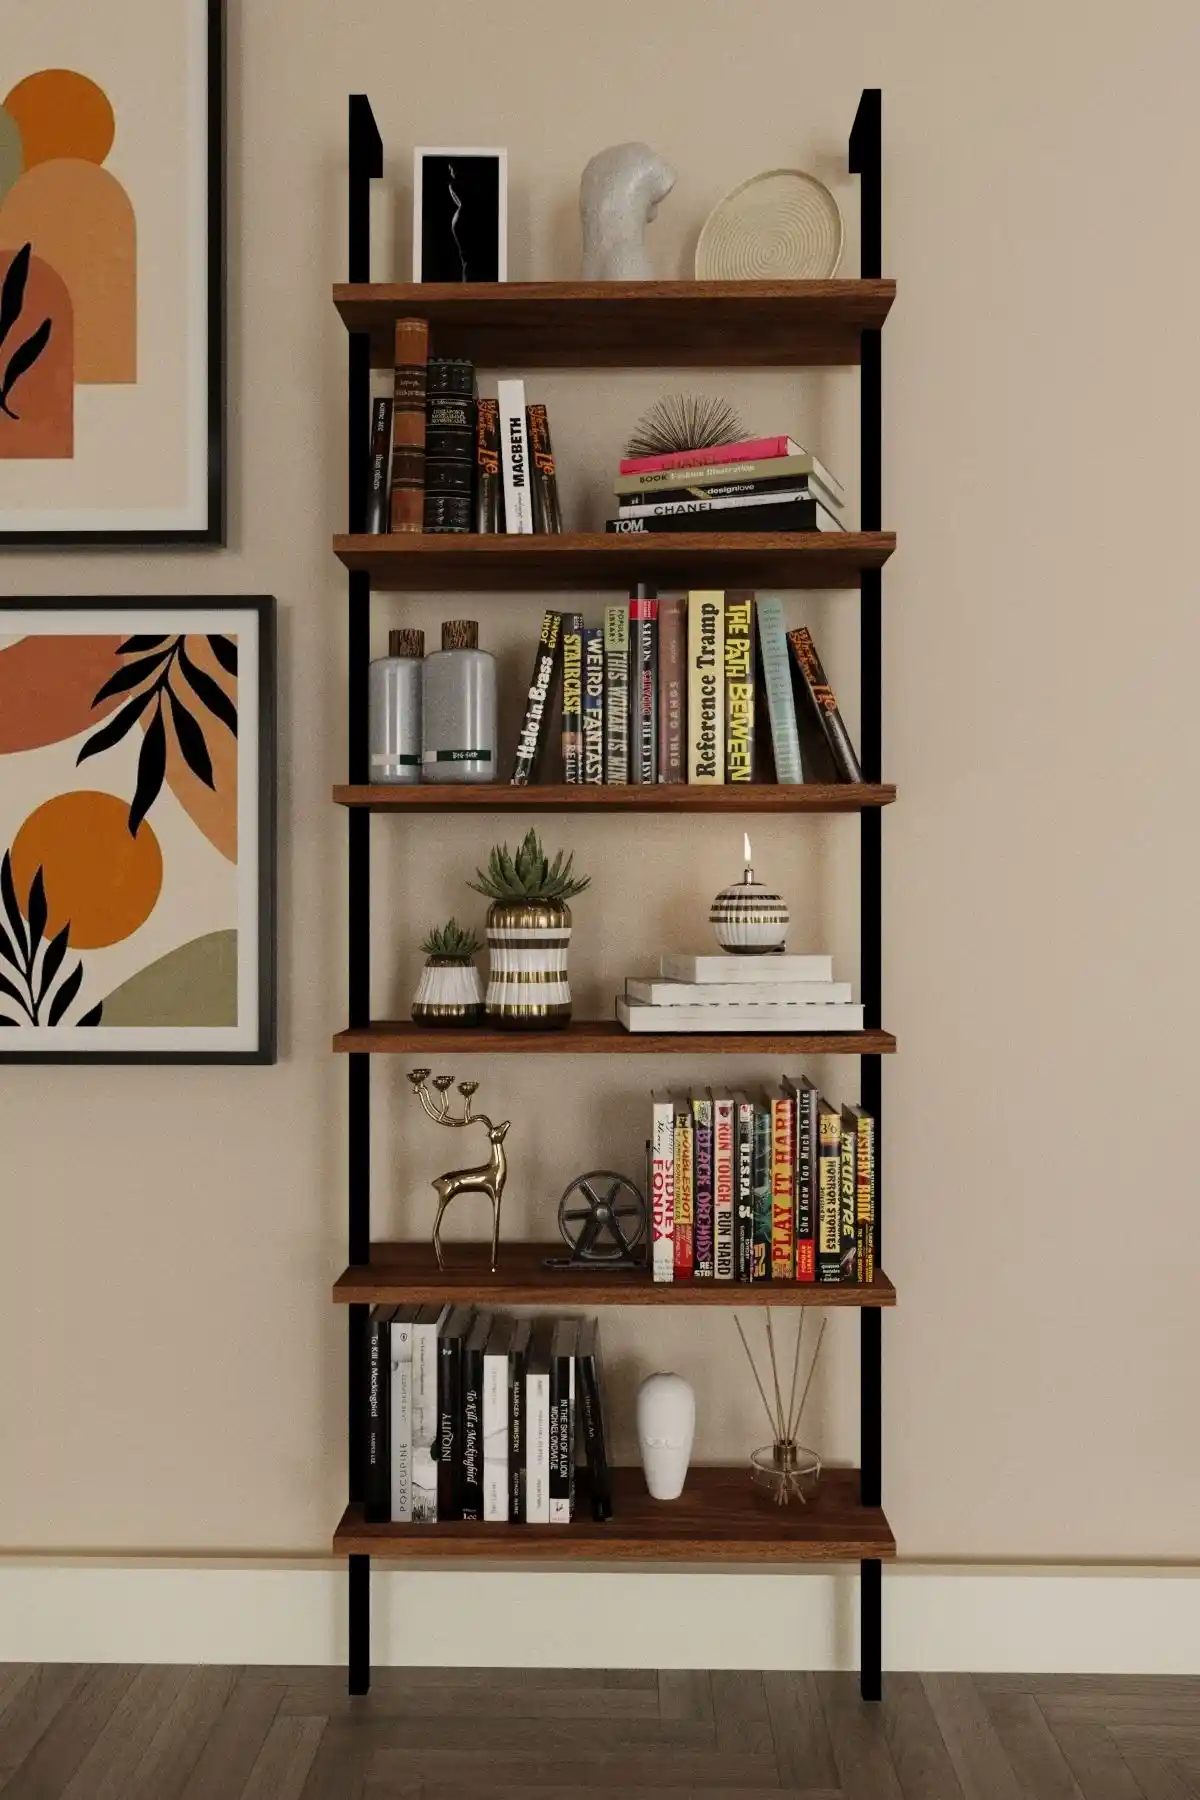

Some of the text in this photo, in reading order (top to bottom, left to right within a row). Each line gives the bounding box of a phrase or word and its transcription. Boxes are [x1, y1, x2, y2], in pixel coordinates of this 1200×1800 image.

[510, 417, 524, 488] MACBETH
[640, 473, 668, 484] BOOK
[707, 484, 755, 496] designlove
[614, 519, 644, 533] TOM
[540, 614, 551, 644] JOHN
[548, 616, 561, 648] EVANS
[608, 609, 616, 643] LIBRARY
[617, 609, 625, 644] POPULAR
[563, 635, 582, 715] STAIRCASE
[607, 652, 627, 680] THIS
[696, 602, 717, 778] Reference Tramp
[725, 600, 754, 781] THE PATH BETWEEN
[517, 656, 554, 759] Halo in Brass
[583, 638, 602, 784] WEIRD FANTASY
[607, 686, 627, 733] WOMAN
[670, 680, 680, 767] GIRL GANGS
[565, 744, 576, 784] REILLY
[607, 738, 627, 752] IS
[681, 1130, 691, 1220] DOUBLESHOT
[740, 1143, 750, 1200] U.E.S.P.A.
[773, 1100, 792, 1261] PLAY IT HARD
[799, 1092, 810, 1233] She Knew Too Much To Live
[841, 1134, 855, 1239] MEURTRE
[858, 1118, 872, 1221] MYSTERY BOOK
[653, 1160, 664, 1242] FONDA
[665, 1160, 674, 1240] SIDNEY
[697, 1129, 712, 1262] BLACK ORCHIDS
[716, 1123, 732, 1276] RUN TOUGH, RUN HARD
[826, 1160, 836, 1250] HORROR STORIES
[371, 1335, 379, 1345] To
[371, 1346, 379, 1360] Kill
[369, 1368, 379, 1417] Mockingbird
[466, 1390, 477, 1402] To
[466, 1403, 477, 1421] Kill
[560, 1399, 568, 1407] IN
[560, 1409, 568, 1423] THE
[442, 1413, 454, 1462] INIQUITY
[463, 1429, 478, 1485] Mockingbird
[550, 1406, 558, 1470] MICHAEL ONDAATJE
[560, 1424, 568, 1441] SKIN
[560, 1442, 568, 1453] OF
[398, 1443, 408, 1512] PORCUPINE
[560, 1460, 568, 1478] LION
[463, 1512, 477, 1520] Lee
